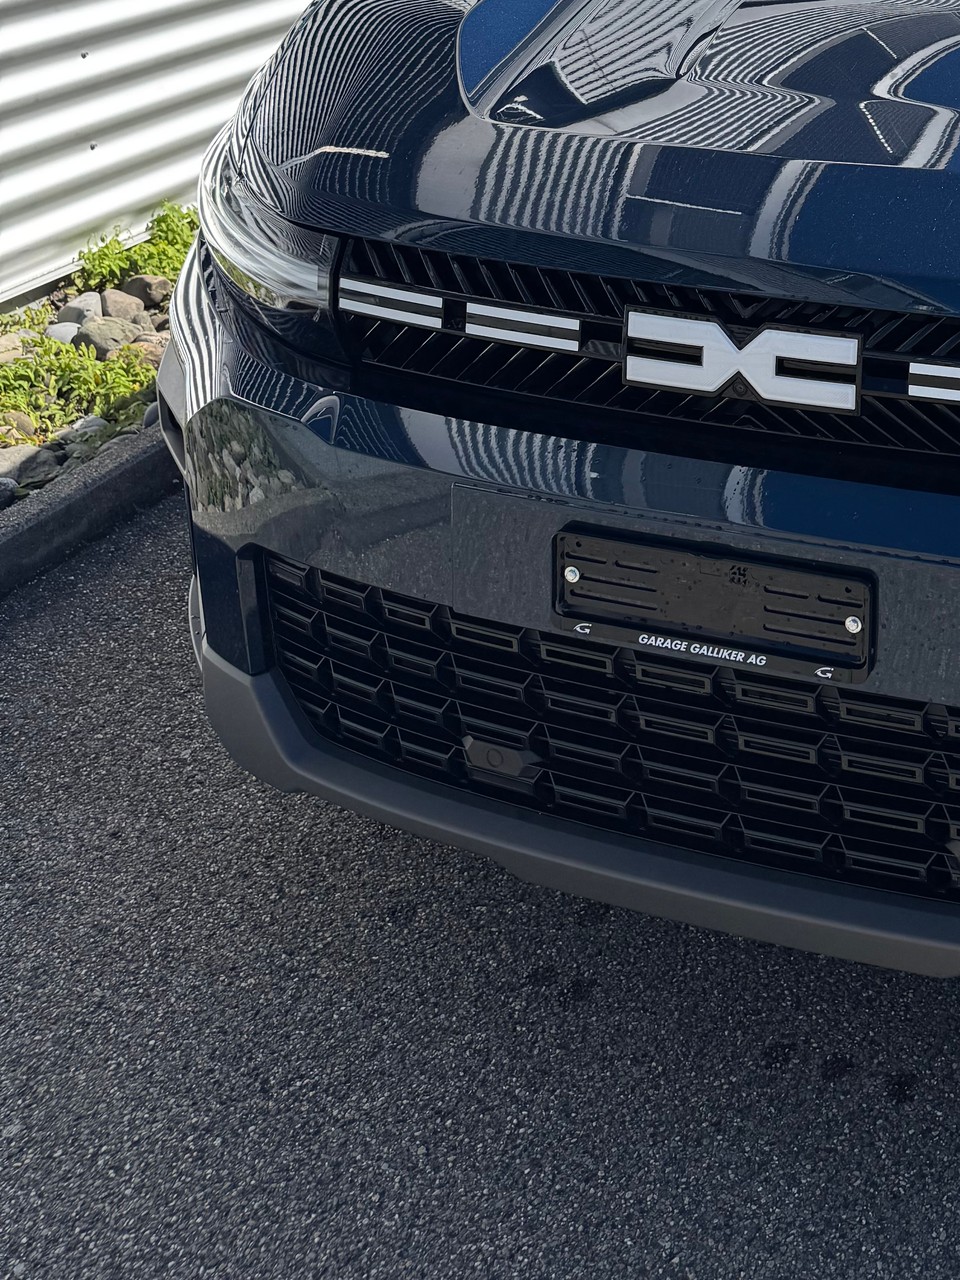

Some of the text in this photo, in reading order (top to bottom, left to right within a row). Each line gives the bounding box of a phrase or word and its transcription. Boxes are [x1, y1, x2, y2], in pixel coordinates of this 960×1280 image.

[638, 634, 767, 666] GARAGE GALLIKER AG
